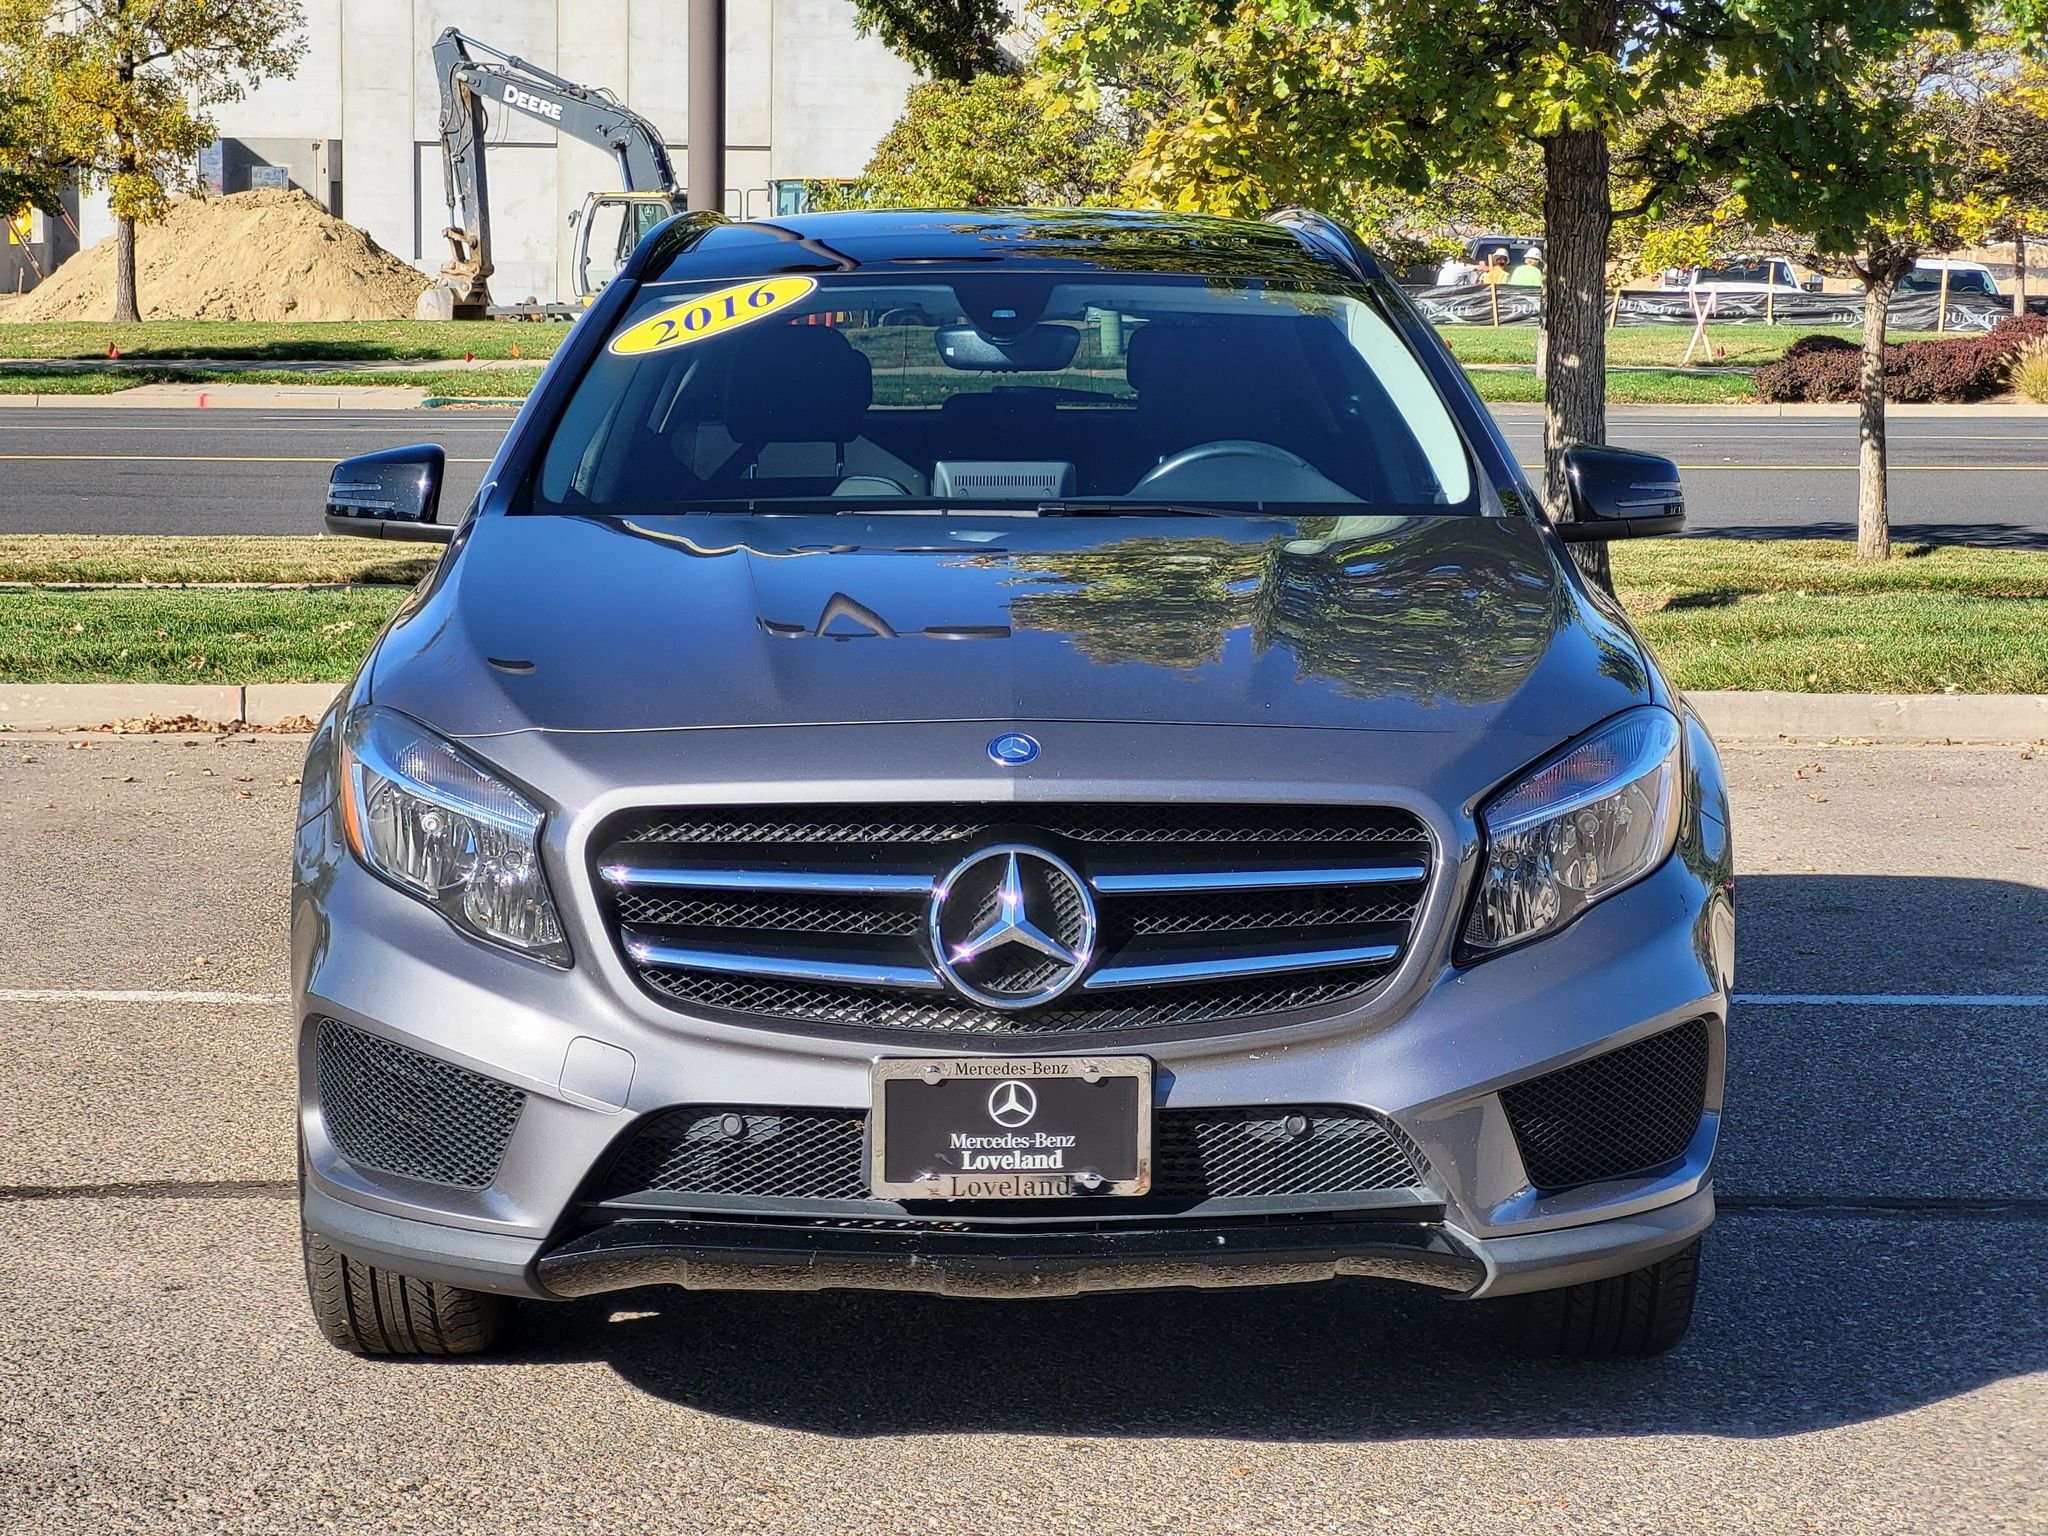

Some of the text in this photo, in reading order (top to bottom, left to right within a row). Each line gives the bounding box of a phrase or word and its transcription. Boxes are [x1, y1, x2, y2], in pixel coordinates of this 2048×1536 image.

[503, 84, 563, 121] DEERE
[651, 283, 775, 346] 2016
[954, 1062, 1069, 1076] Mercedes-Benz
[950, 1132, 1076, 1149] Mercedes-Benz
[961, 1150, 1064, 1170] Loveland
[950, 1174, 1072, 1197] Loveland
